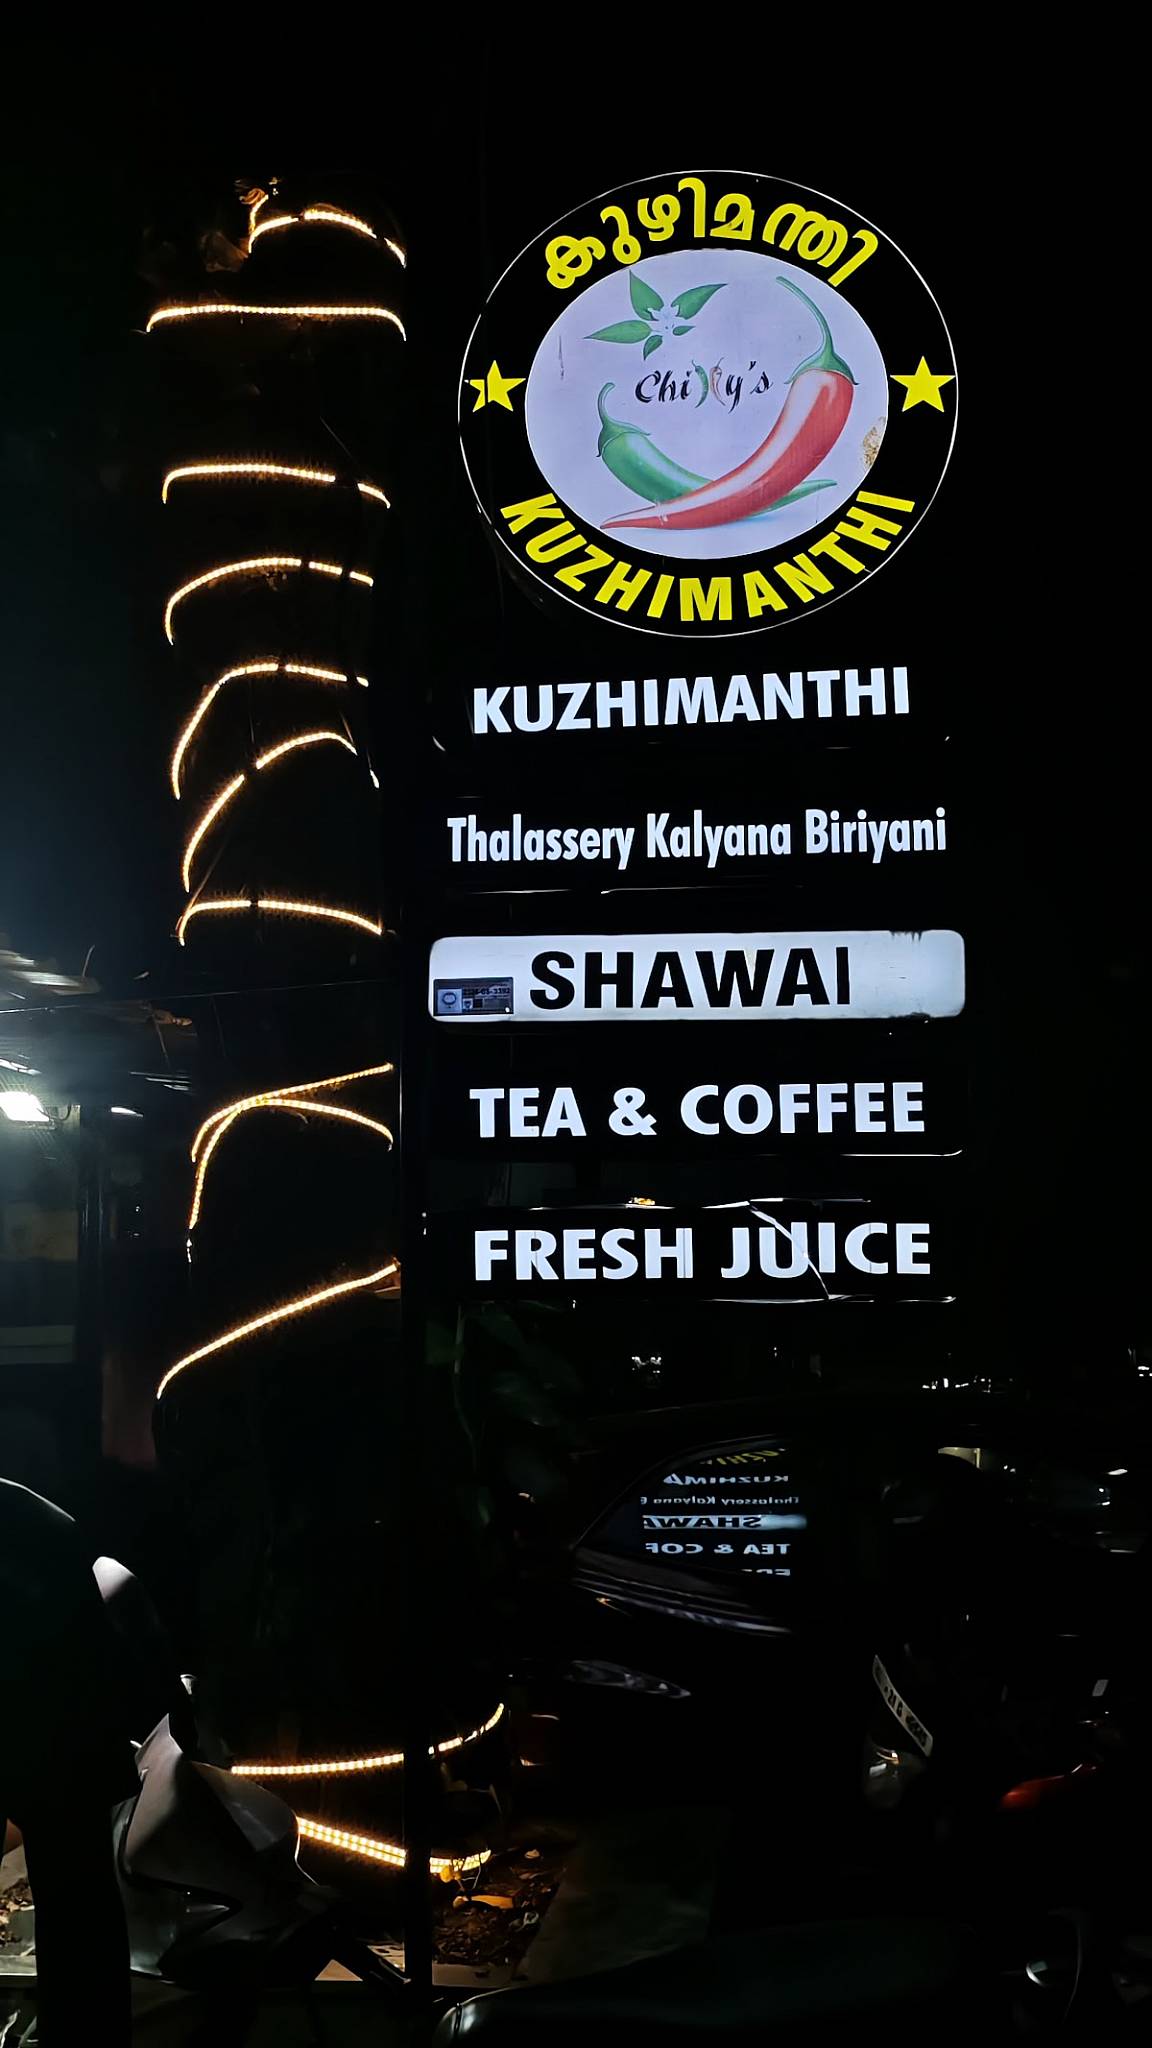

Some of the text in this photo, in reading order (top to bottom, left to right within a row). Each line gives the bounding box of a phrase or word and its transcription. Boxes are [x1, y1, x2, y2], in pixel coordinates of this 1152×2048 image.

[545, 177, 879, 290] കുഴിമന്തി
[500, 490, 915, 621] KUZHIMANTHI
[473, 666, 910, 734] KUZHIMANTHI
[447, 807, 947, 870] Thalassery Kalyana Biriyani
[529, 946, 851, 1010] SHAWAI
[469, 1082, 925, 1138] TEA & COFFEE
[474, 1222, 931, 1281] FRESH JUICE
